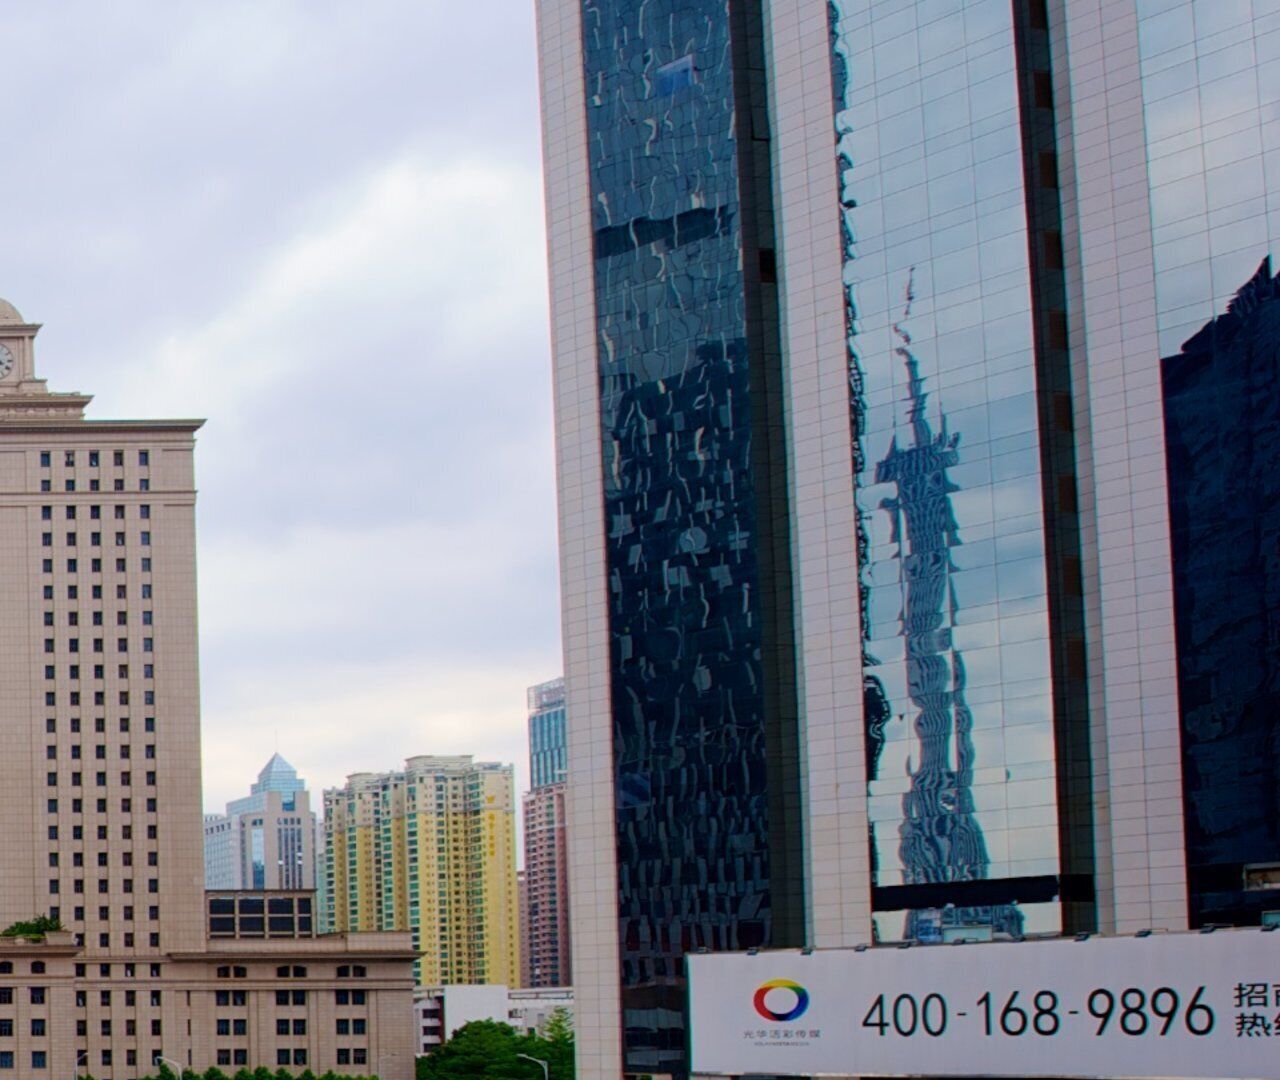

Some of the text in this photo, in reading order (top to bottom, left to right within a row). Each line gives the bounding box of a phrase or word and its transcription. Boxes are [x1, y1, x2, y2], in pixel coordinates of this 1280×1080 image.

[1234, 982, 1280, 1008] 招
[862, 985, 1216, 1038] 400-168-9896
[1236, 1013, 1280, 1037] 热
